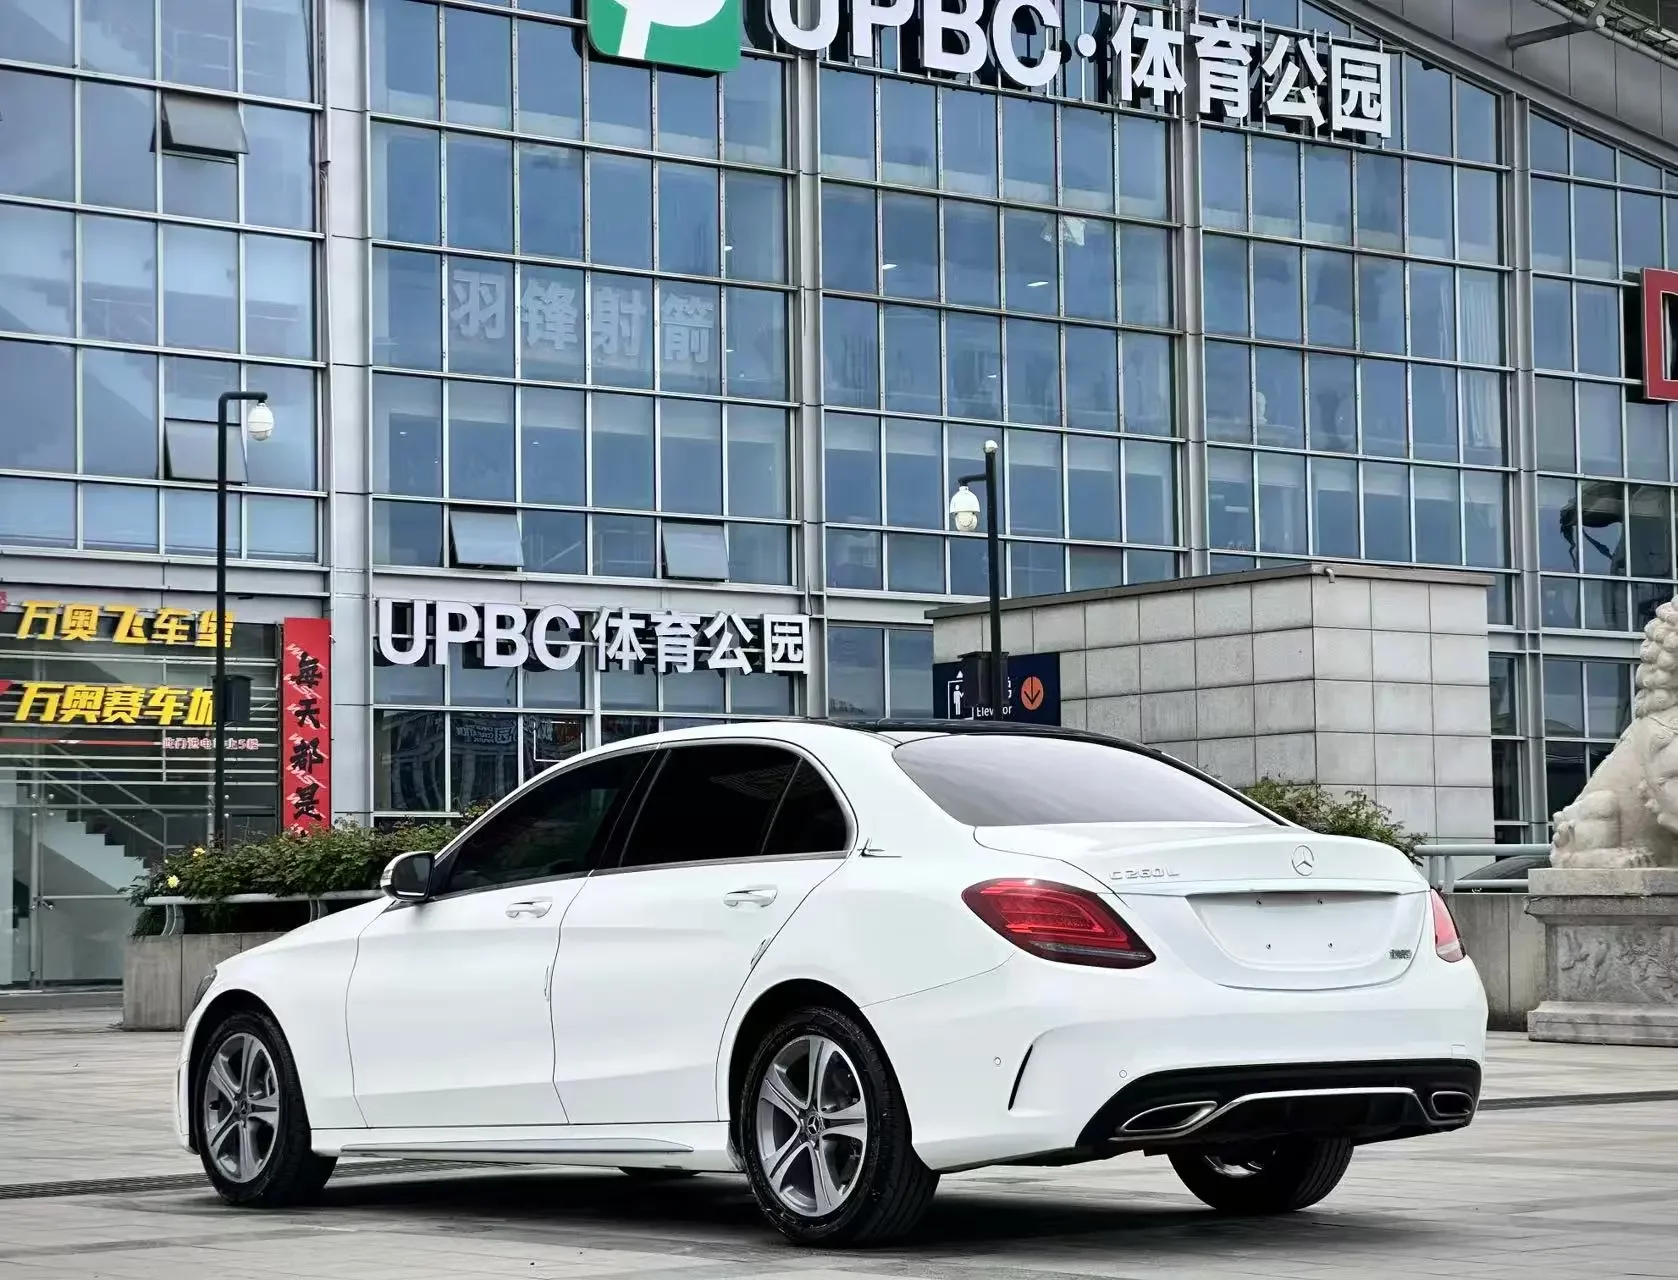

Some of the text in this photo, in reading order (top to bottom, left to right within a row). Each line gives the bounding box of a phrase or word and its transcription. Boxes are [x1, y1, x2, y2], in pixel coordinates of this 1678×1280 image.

[450, 268, 715, 363] 羽锋射箭
[16, 600, 235, 648] 万奥飞车堡
[976, 706, 1013, 718] Elevor
